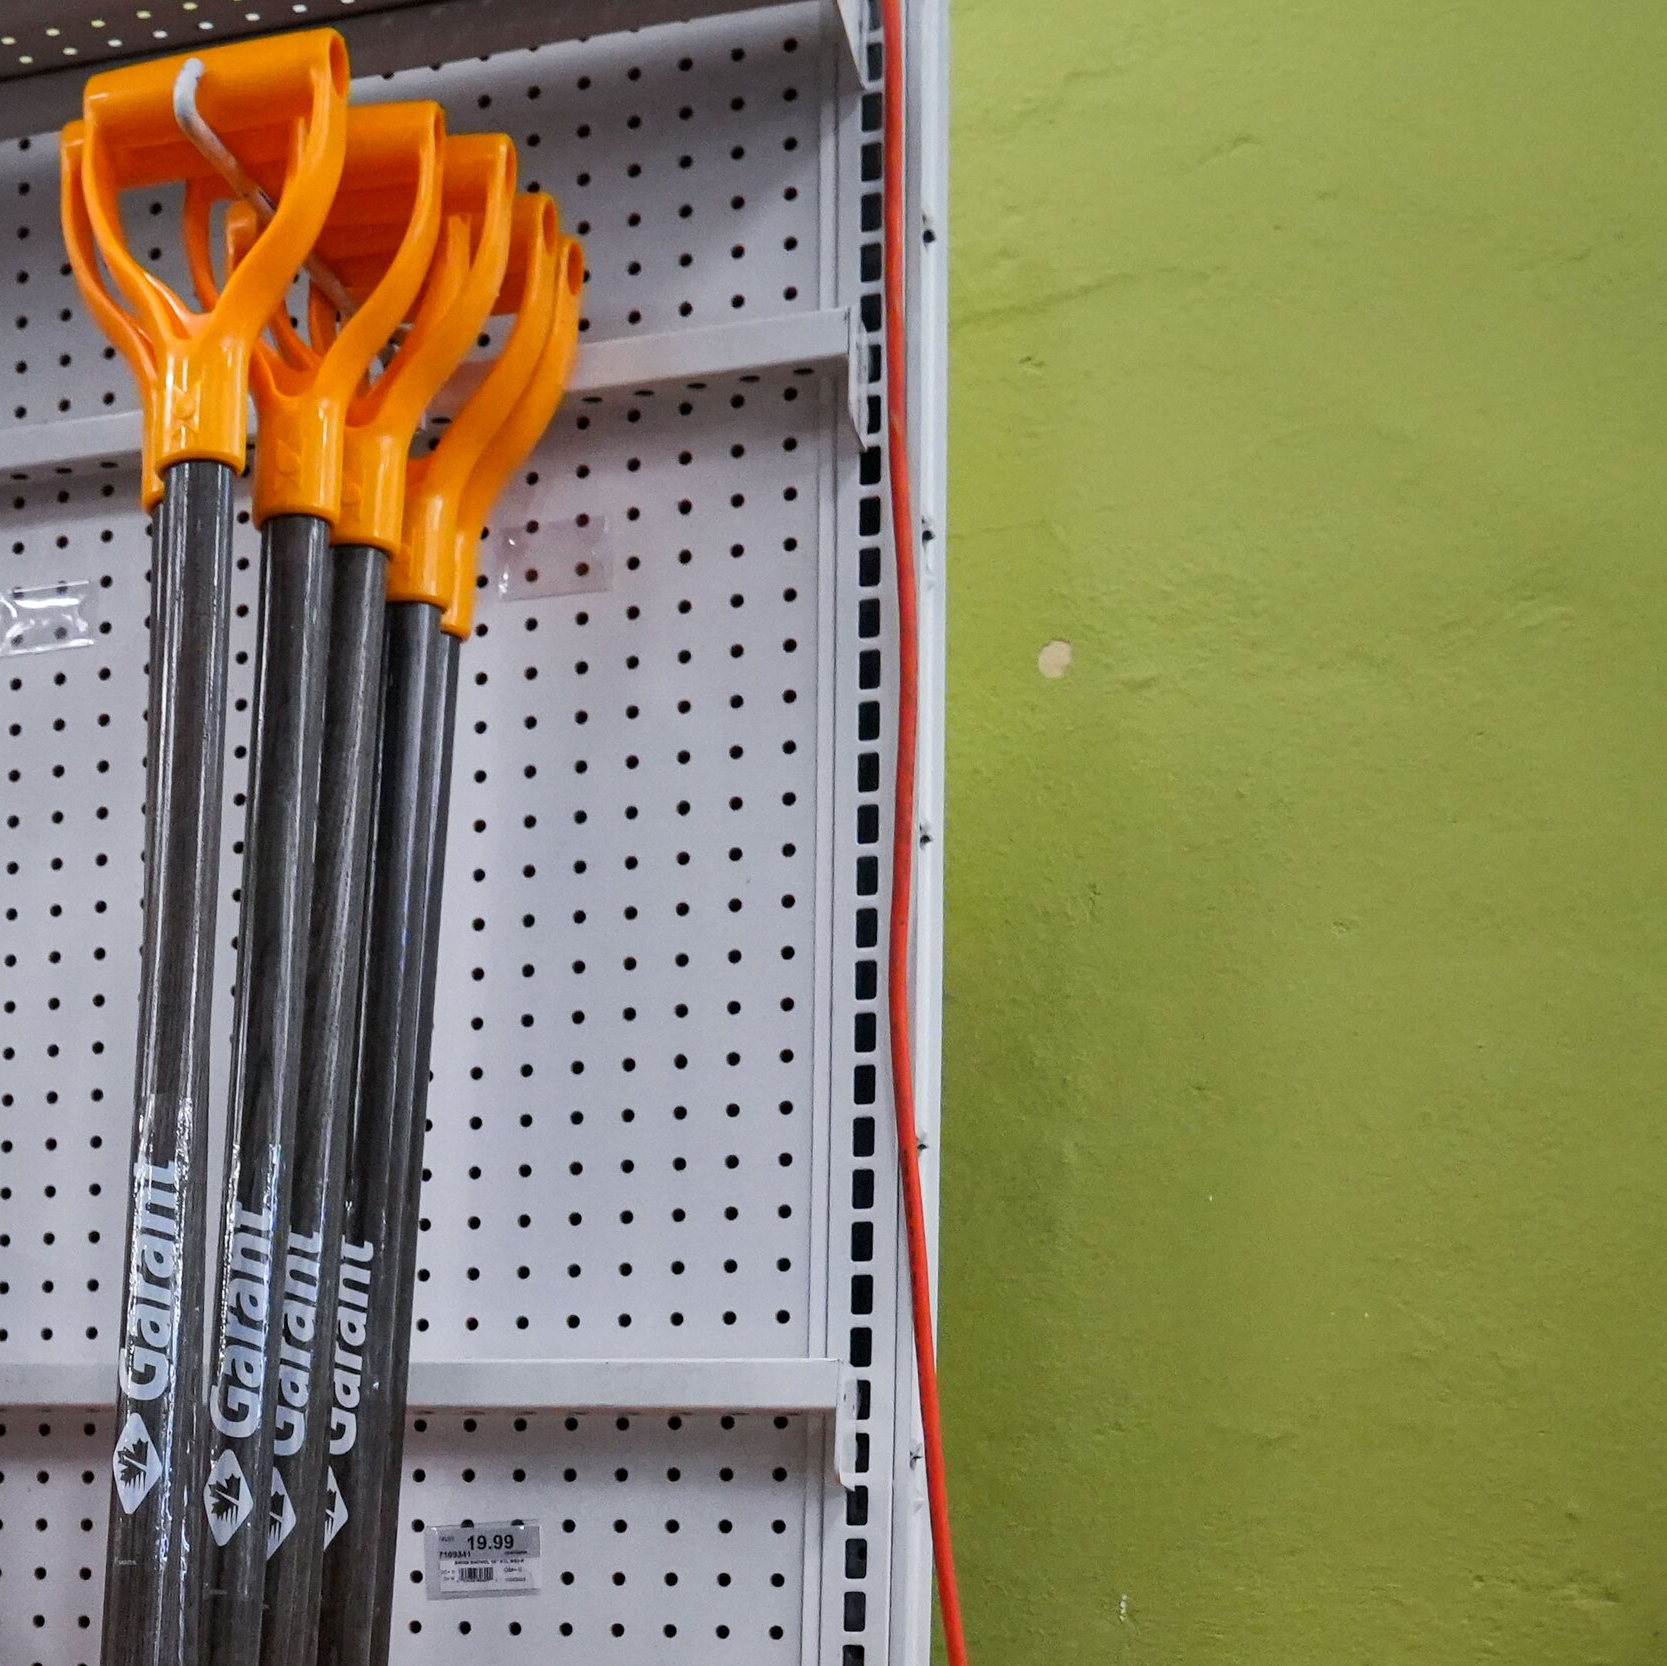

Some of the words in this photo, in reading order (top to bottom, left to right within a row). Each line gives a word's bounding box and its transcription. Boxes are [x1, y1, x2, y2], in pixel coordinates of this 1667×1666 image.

[118, 1159, 177, 1402] Garant
[209, 1201, 273, 1439] Garant
[273, 1230, 322, 1457] Garant
[328, 1235, 374, 1456] Garant
[467, 1534, 514, 1550] 19.99
